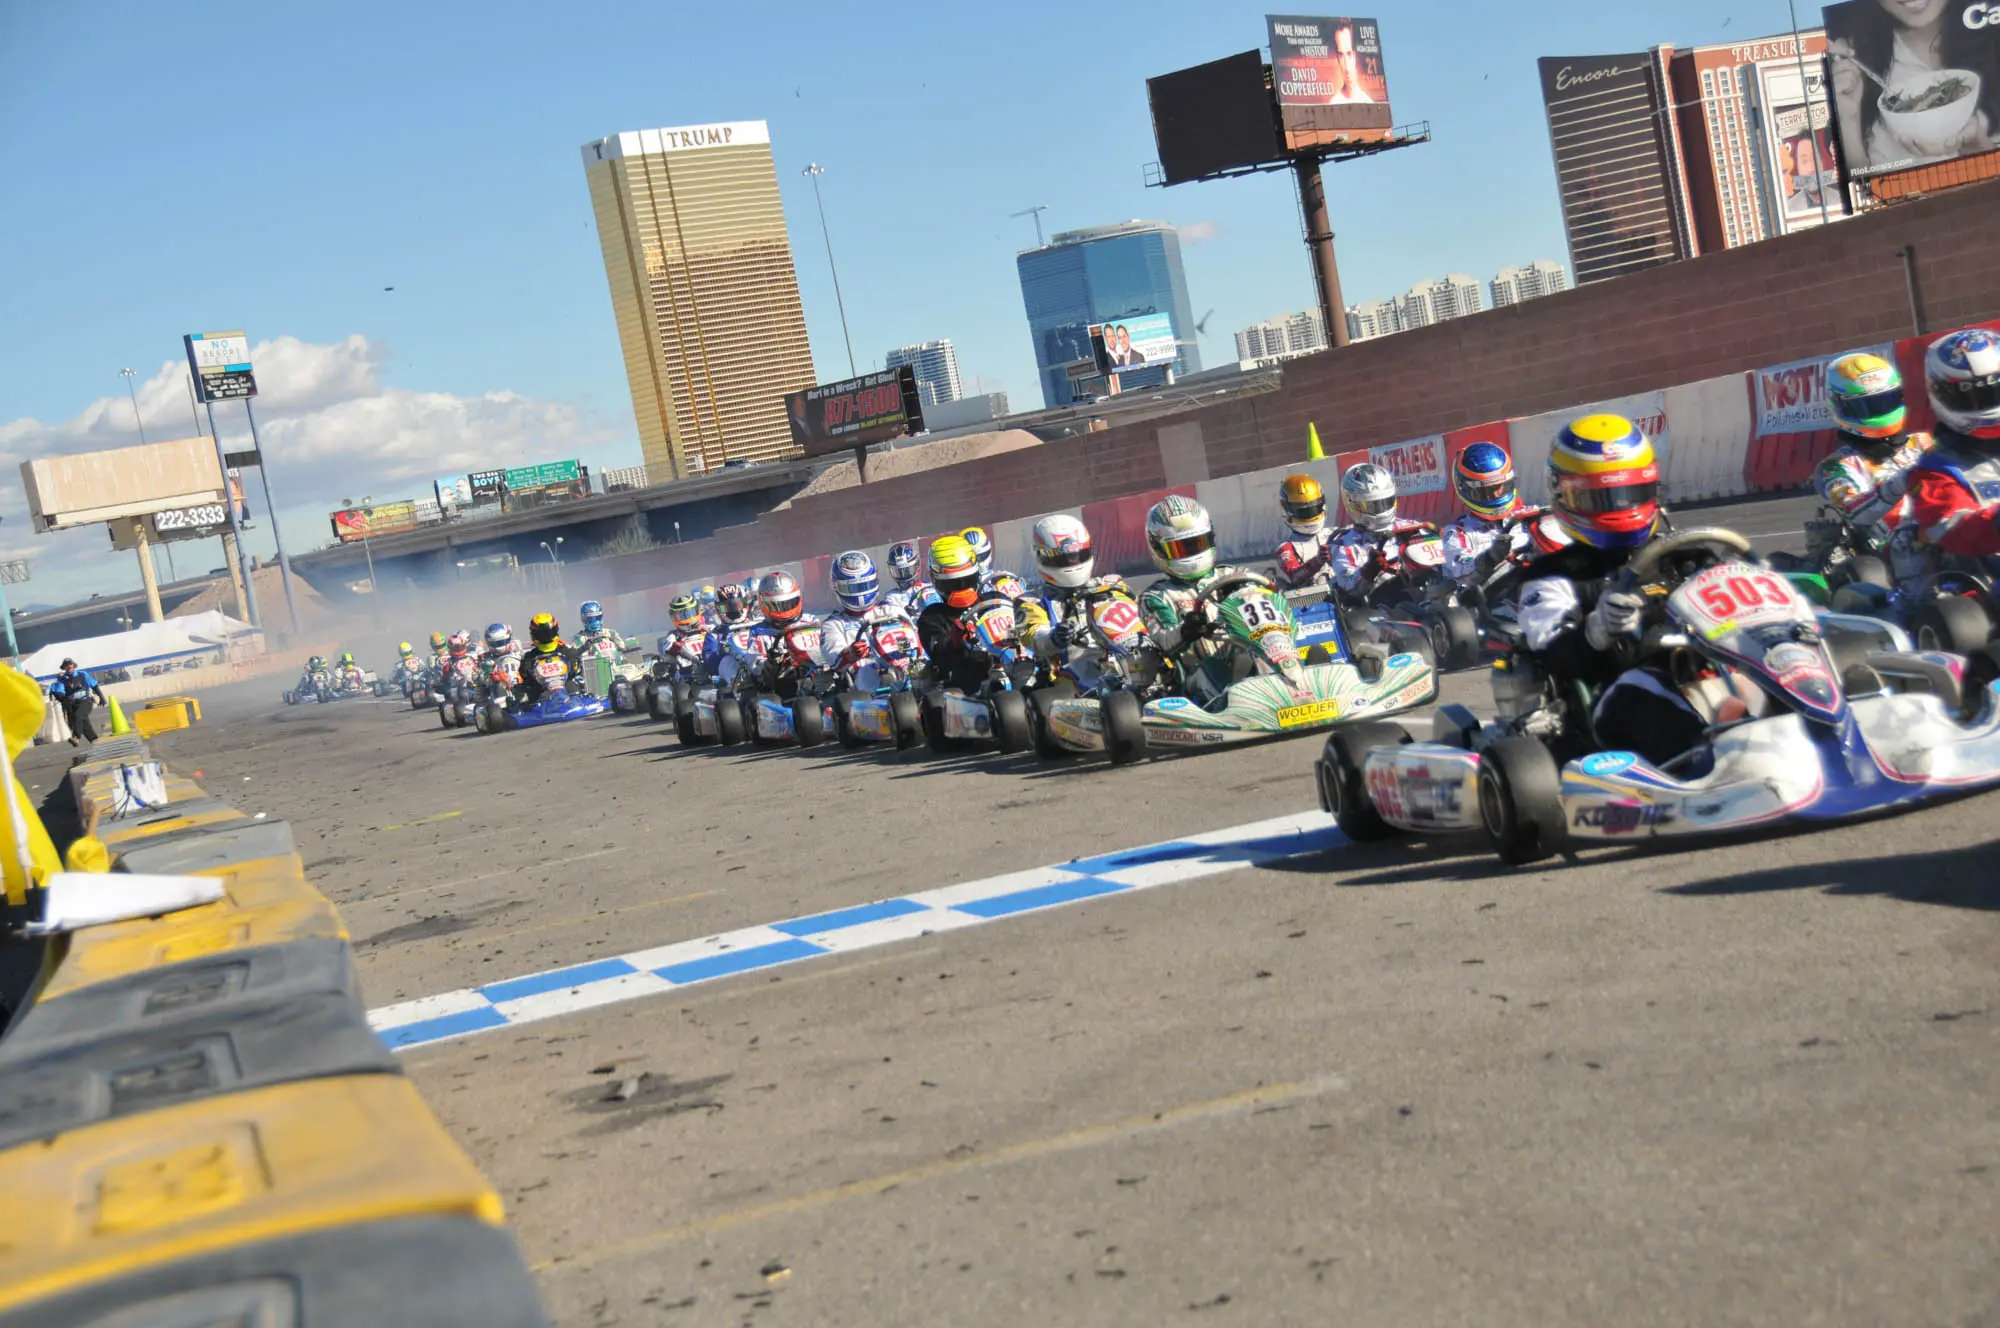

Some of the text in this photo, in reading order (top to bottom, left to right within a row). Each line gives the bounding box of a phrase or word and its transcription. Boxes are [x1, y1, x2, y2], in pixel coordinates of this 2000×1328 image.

[1274, 23, 1319, 37] MORE AWARDS
[1305, 45, 1328, 57] HISTORY
[1731, 39, 1807, 63] TREASURE
[1291, 67, 1317, 82] DAVID
[1555, 65, 1622, 91] Encore
[1280, 80, 1333, 97] COPPERFIELD
[1779, 114, 1802, 127] TERRY
[666, 126, 733, 149] TRUMP
[1850, 157, 1914, 177] RioLocals.com
[1762, 361, 1829, 411] MOTH
[824, 383, 900, 427] 877-1500
[156, 505, 226, 530] 222-3333
[1699, 575, 1791, 618] 503
[1243, 601, 1276, 627] 35
[542, 664, 560, 675] 255
[1279, 701, 1335, 720] WOLTJER
